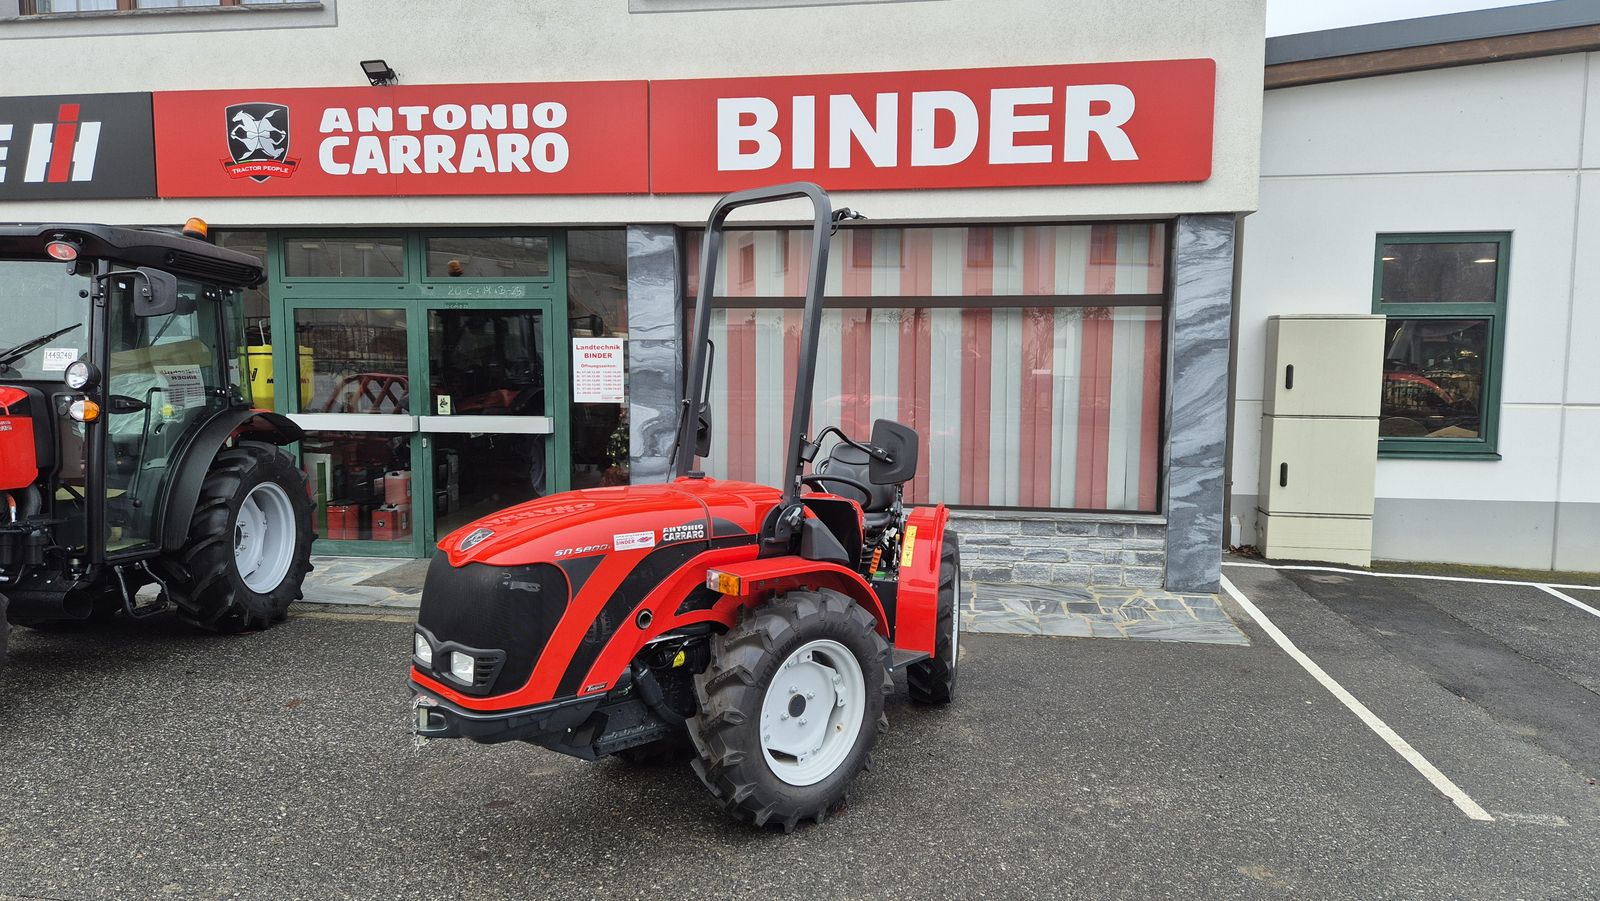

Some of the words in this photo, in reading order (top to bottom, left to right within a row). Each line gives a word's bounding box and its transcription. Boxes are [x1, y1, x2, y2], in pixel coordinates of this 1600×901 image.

[319, 101, 568, 133] ANTONIO
[717, 83, 1140, 171] BINDER
[318, 132, 569, 175] CARRARO
[232, 165, 262, 174] TRACTOR
[263, 165, 289, 173] PEOPLE
[662, 524, 704, 534] ANTONIO
[662, 530, 704, 542] CARRARO
